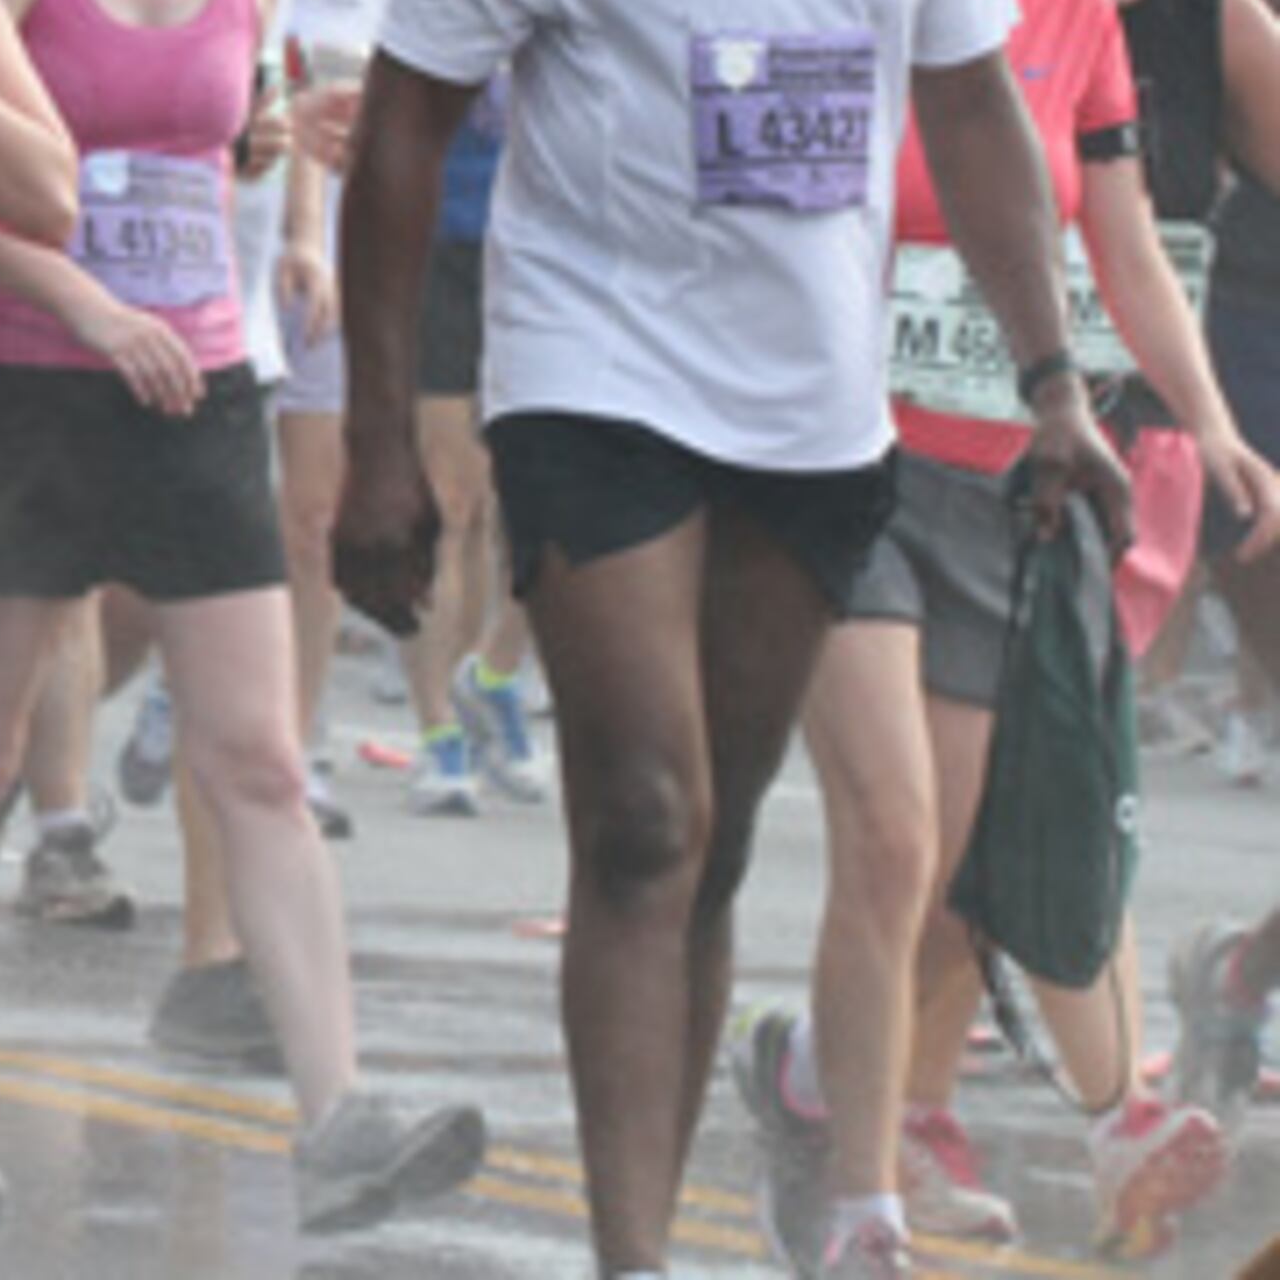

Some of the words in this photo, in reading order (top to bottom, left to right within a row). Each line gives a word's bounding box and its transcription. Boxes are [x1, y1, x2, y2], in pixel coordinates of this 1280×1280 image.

[716, 111, 746, 160] L
[84, 214, 108, 261] L
[893, 313, 940, 361] M
